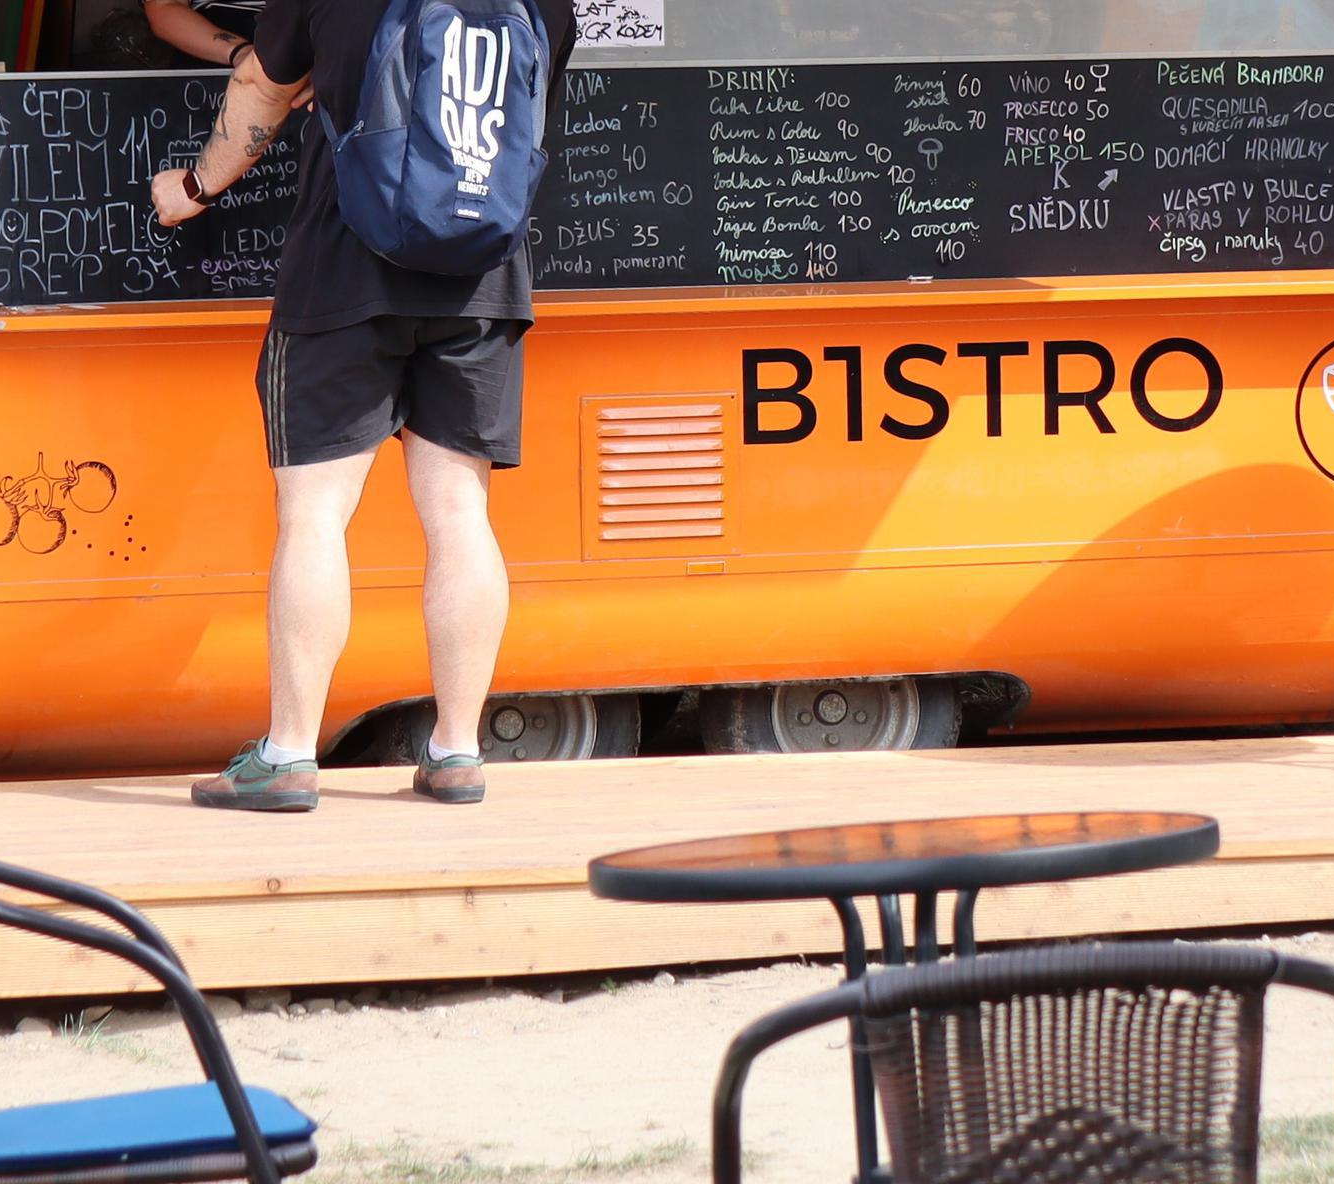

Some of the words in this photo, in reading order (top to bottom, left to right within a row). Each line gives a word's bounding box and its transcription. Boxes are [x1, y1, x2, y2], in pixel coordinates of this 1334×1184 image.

[958, 73, 982, 98] 60
[1064, 69, 1086, 91] 40
[23, 82, 110, 137] ČEPU
[636, 102, 658, 128] 75
[709, 96, 751, 115] Cuba
[756, 95, 804, 114] Libre
[815, 92, 850, 111] 100
[1003, 100, 1079, 120] PROSECCO
[1085, 99, 1110, 121] 50
[1161, 96, 1269, 120] QUESADILLA
[709, 121, 760, 141] Rum
[837, 119, 859, 140] 90
[967, 110, 987, 130] 70
[1004, 126, 1059, 146] FRISCO
[1063, 124, 1086, 144] 40
[565, 143, 611, 166] preso
[622, 144, 647, 173] 40
[866, 143, 892, 164] 90
[1004, 144, 1093, 166] APEROL
[1099, 142, 1145, 162] 150
[1244, 137, 1330, 162] HRANOLKY
[568, 166, 617, 189] lungo
[887, 166, 916, 186] 120
[1052, 160, 1071, 190] K
[663, 181, 693, 206] 60
[716, 194, 756, 214] Gin
[765, 192, 820, 209] Tonic
[828, 190, 862, 207] 100
[897, 186, 975, 216] Prosecco
[1163, 180, 1237, 211] VLASTA
[1264, 178, 1333, 204] BULCE
[762, 214, 826, 234] Bomba
[837, 214, 872, 234] 130
[1009, 195, 1111, 234] SNĚDKU
[1265, 204, 1334, 225] ROHLU
[631, 225, 660, 247] 35
[1224, 227, 1284, 265] nanuky
[1294, 230, 1324, 255] 40
[613, 245, 686, 274] pomeranč
[804, 241, 837, 261] 110
[935, 238, 966, 263] 110
[805, 260, 838, 280] 140
